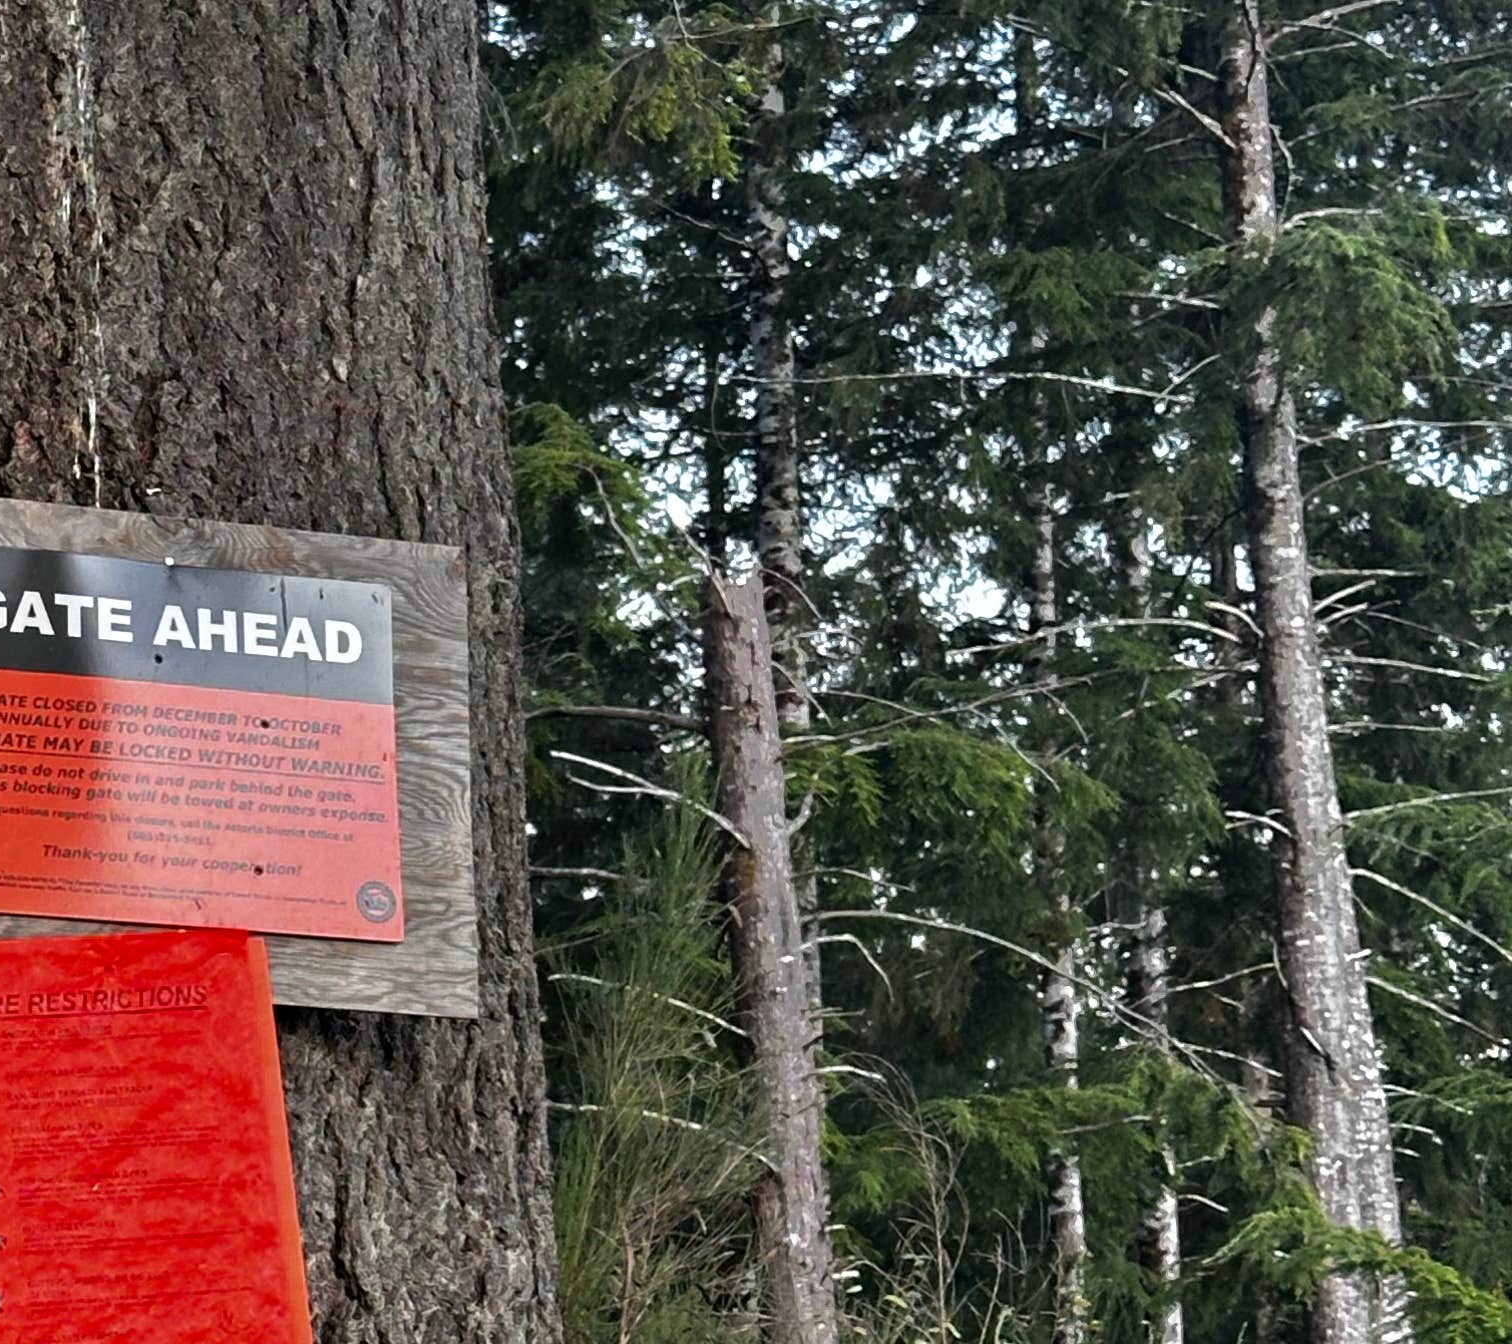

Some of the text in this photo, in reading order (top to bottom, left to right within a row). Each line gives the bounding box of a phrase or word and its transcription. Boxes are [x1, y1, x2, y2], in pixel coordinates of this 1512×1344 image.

[152, 604, 363, 665] AHEAD
[33, 697, 96, 713] CLOSED
[101, 702, 148, 718] FROM
[152, 706, 237, 725] DECEMBER
[268, 717, 342, 736] OCTOBER
[78, 718, 113, 733] DUE
[118, 722, 138, 734] TO
[143, 724, 221, 742] ONGOING
[226, 731, 320, 751] VANDALISM
[43, 736, 85, 752] MAY
[89, 740, 114, 755] BE
[119, 743, 191, 762] LOCKED
[198, 749, 285, 769] WITHOUT
[291, 757, 386, 779] WARNING.
[13, 779, 81, 799] blocking
[86, 785, 123, 801] gate
[127, 788, 157, 803] will
[160, 792, 181, 805] be
[185, 794, 234, 811] towed
[239, 799, 255, 812] at
[258, 802, 316, 817] owners
[320, 807, 388, 823] expense.
[32, 763, 53, 778] do
[57, 767, 85, 781] not
[89, 768, 131, 783] drive
[135, 771, 151, 785] in
[155, 774, 185, 787] and
[188, 776, 226, 792] park
[230, 779, 284, 796] behind
[287, 783, 313, 799] the
[317, 788, 356, 803] gate.
[42, 844, 303, 877] Thank-you for your coopertion!
[27, 984, 209, 1014] RESTRICTIONS
